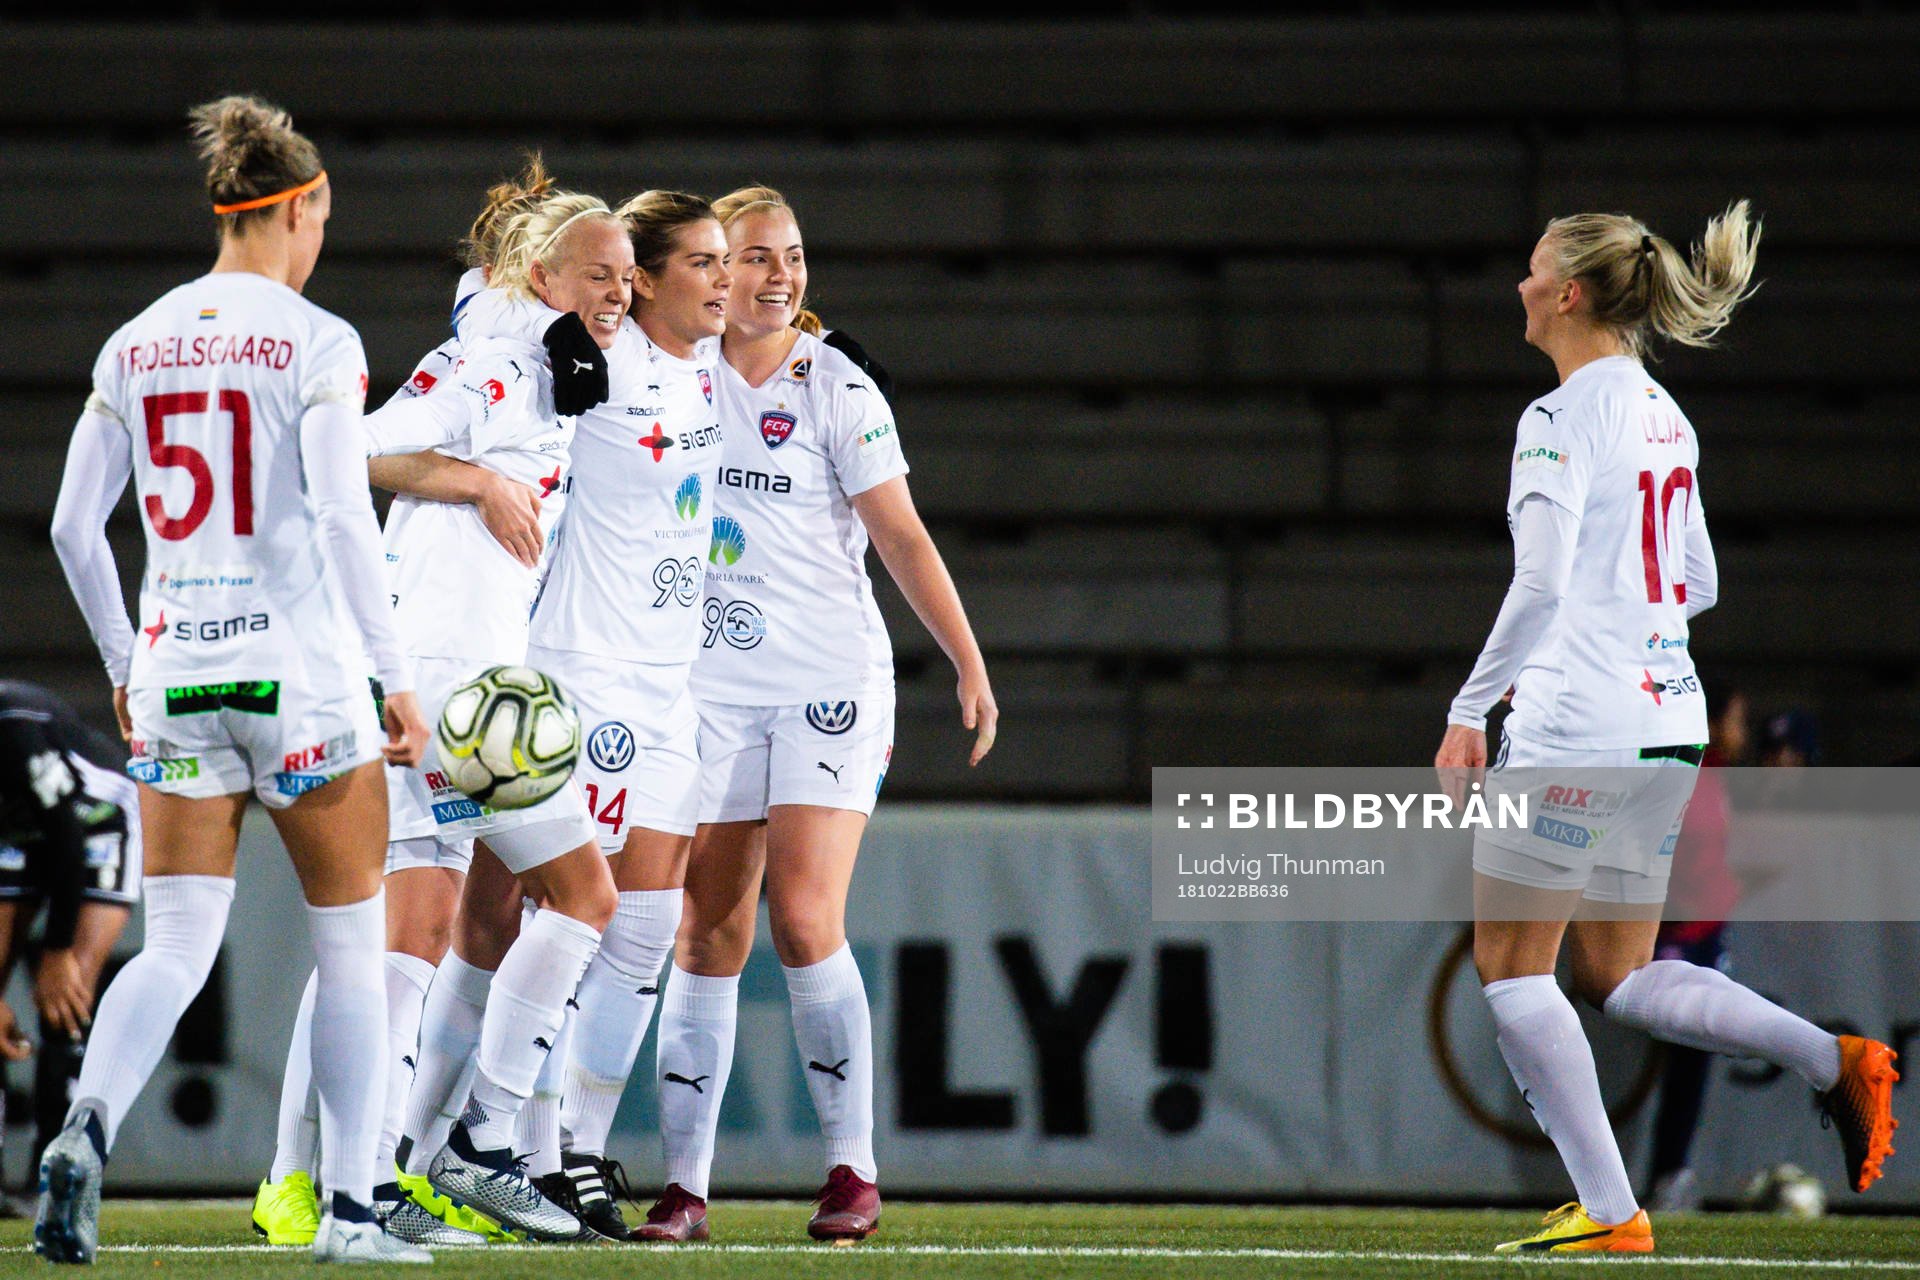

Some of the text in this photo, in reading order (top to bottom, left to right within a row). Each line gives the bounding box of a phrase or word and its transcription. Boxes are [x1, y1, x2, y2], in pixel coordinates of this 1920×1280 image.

[118, 335, 293, 375] TROELSGAARD
[763, 418, 791, 434] FCR
[865, 423, 896, 443] PEA
[1641, 414, 1688, 444] LILJA
[143, 388, 254, 542] 51
[1519, 447, 1560, 462] PEAB
[718, 466, 792, 493] IGma
[1638, 466, 1692, 605] 10
[1666, 675, 1698, 696] SIG
[438, 802, 476, 820] MKB
[586, 783, 628, 835] 14
[1541, 820, 1585, 844] MKB
